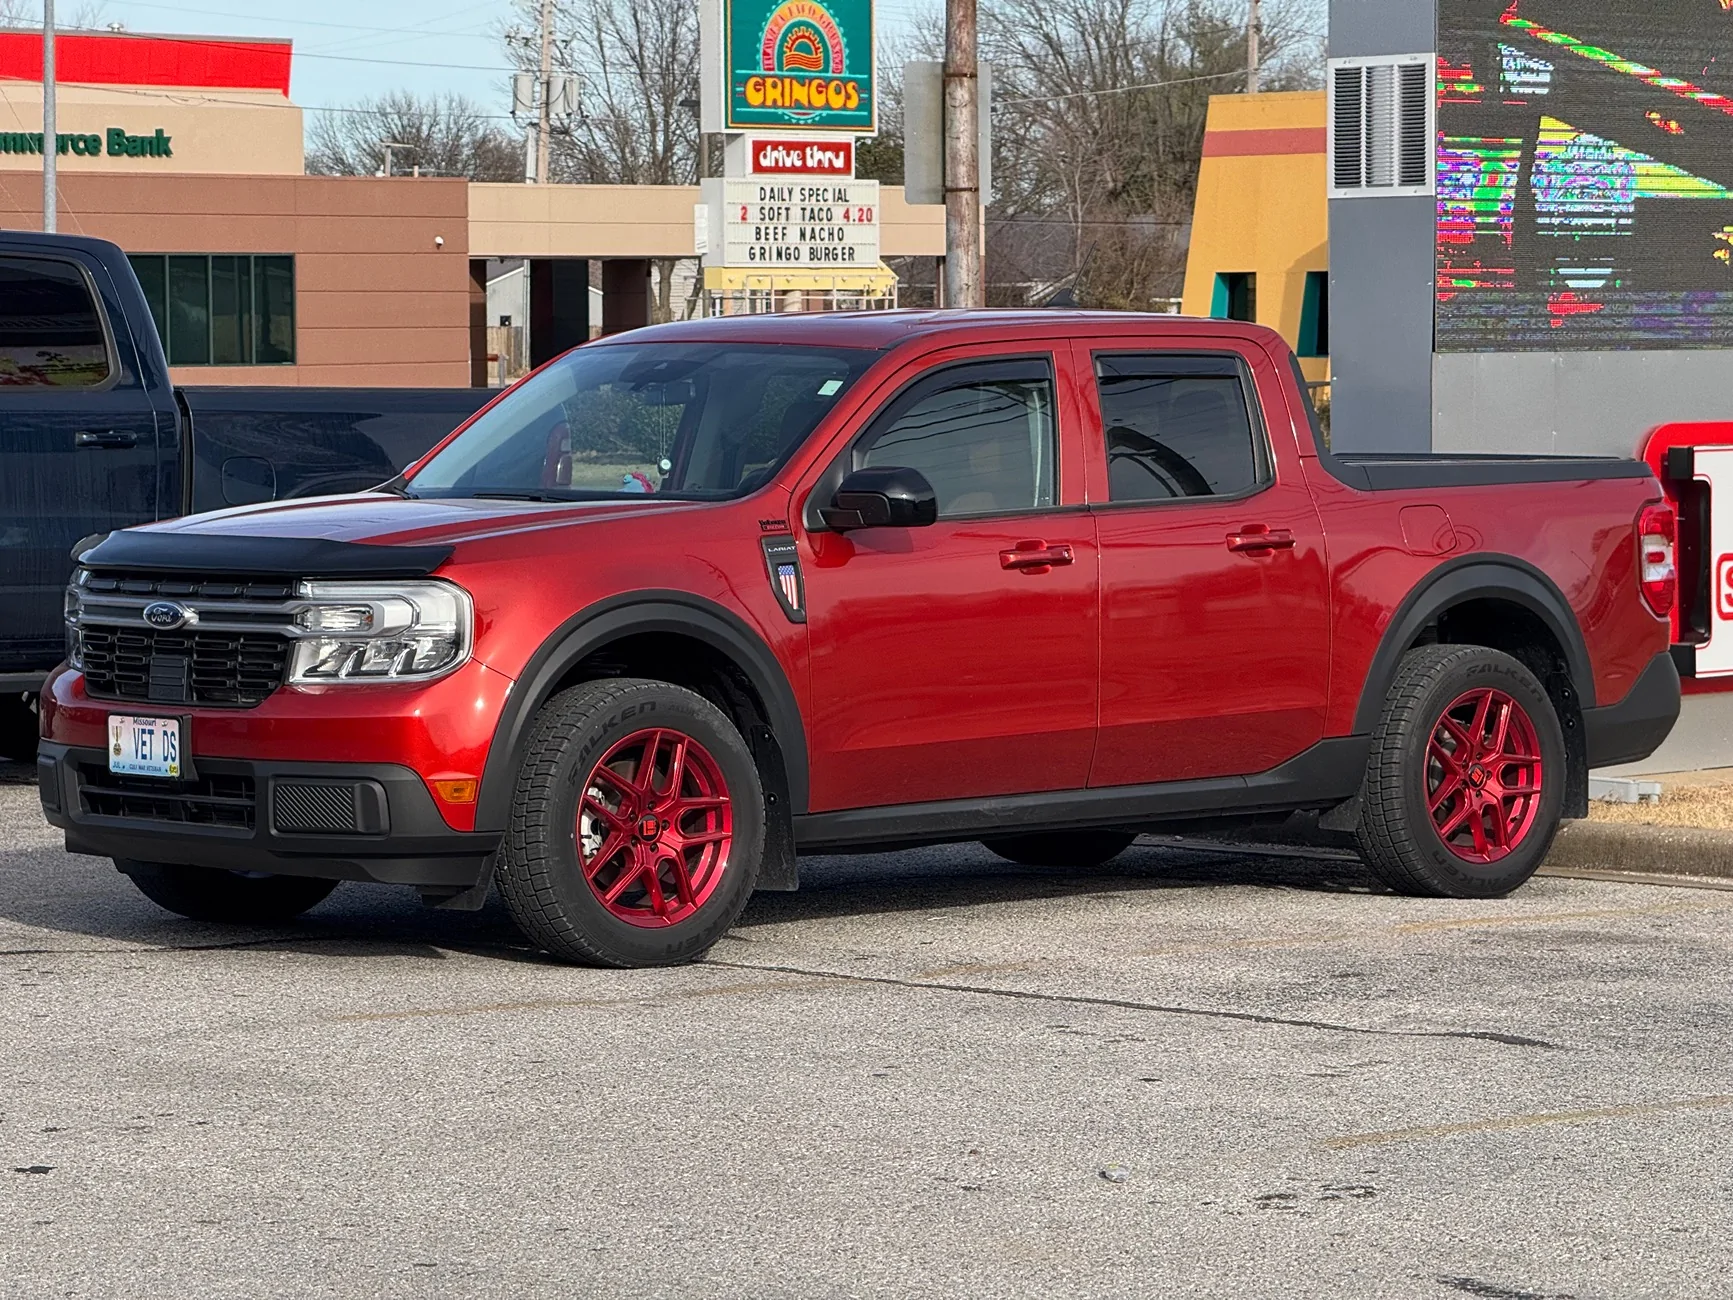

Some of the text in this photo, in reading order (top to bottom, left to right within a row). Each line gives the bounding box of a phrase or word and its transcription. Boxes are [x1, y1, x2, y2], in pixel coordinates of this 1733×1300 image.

[745, 76, 860, 109] GRINGOS
[106, 127, 173, 158] Bank
[759, 145, 845, 168] drive thru
[759, 186, 850, 203] DAILY SPECIAL
[740, 205, 873, 223] 2 SOFT TACO 4.20
[755, 226, 845, 242] BEEF NACHO
[748, 246, 855, 262] GRINGO BURGER
[151, 606, 174, 623] Ford
[132, 718, 157, 727] Missouri
[132, 727, 177, 762] VET DS
